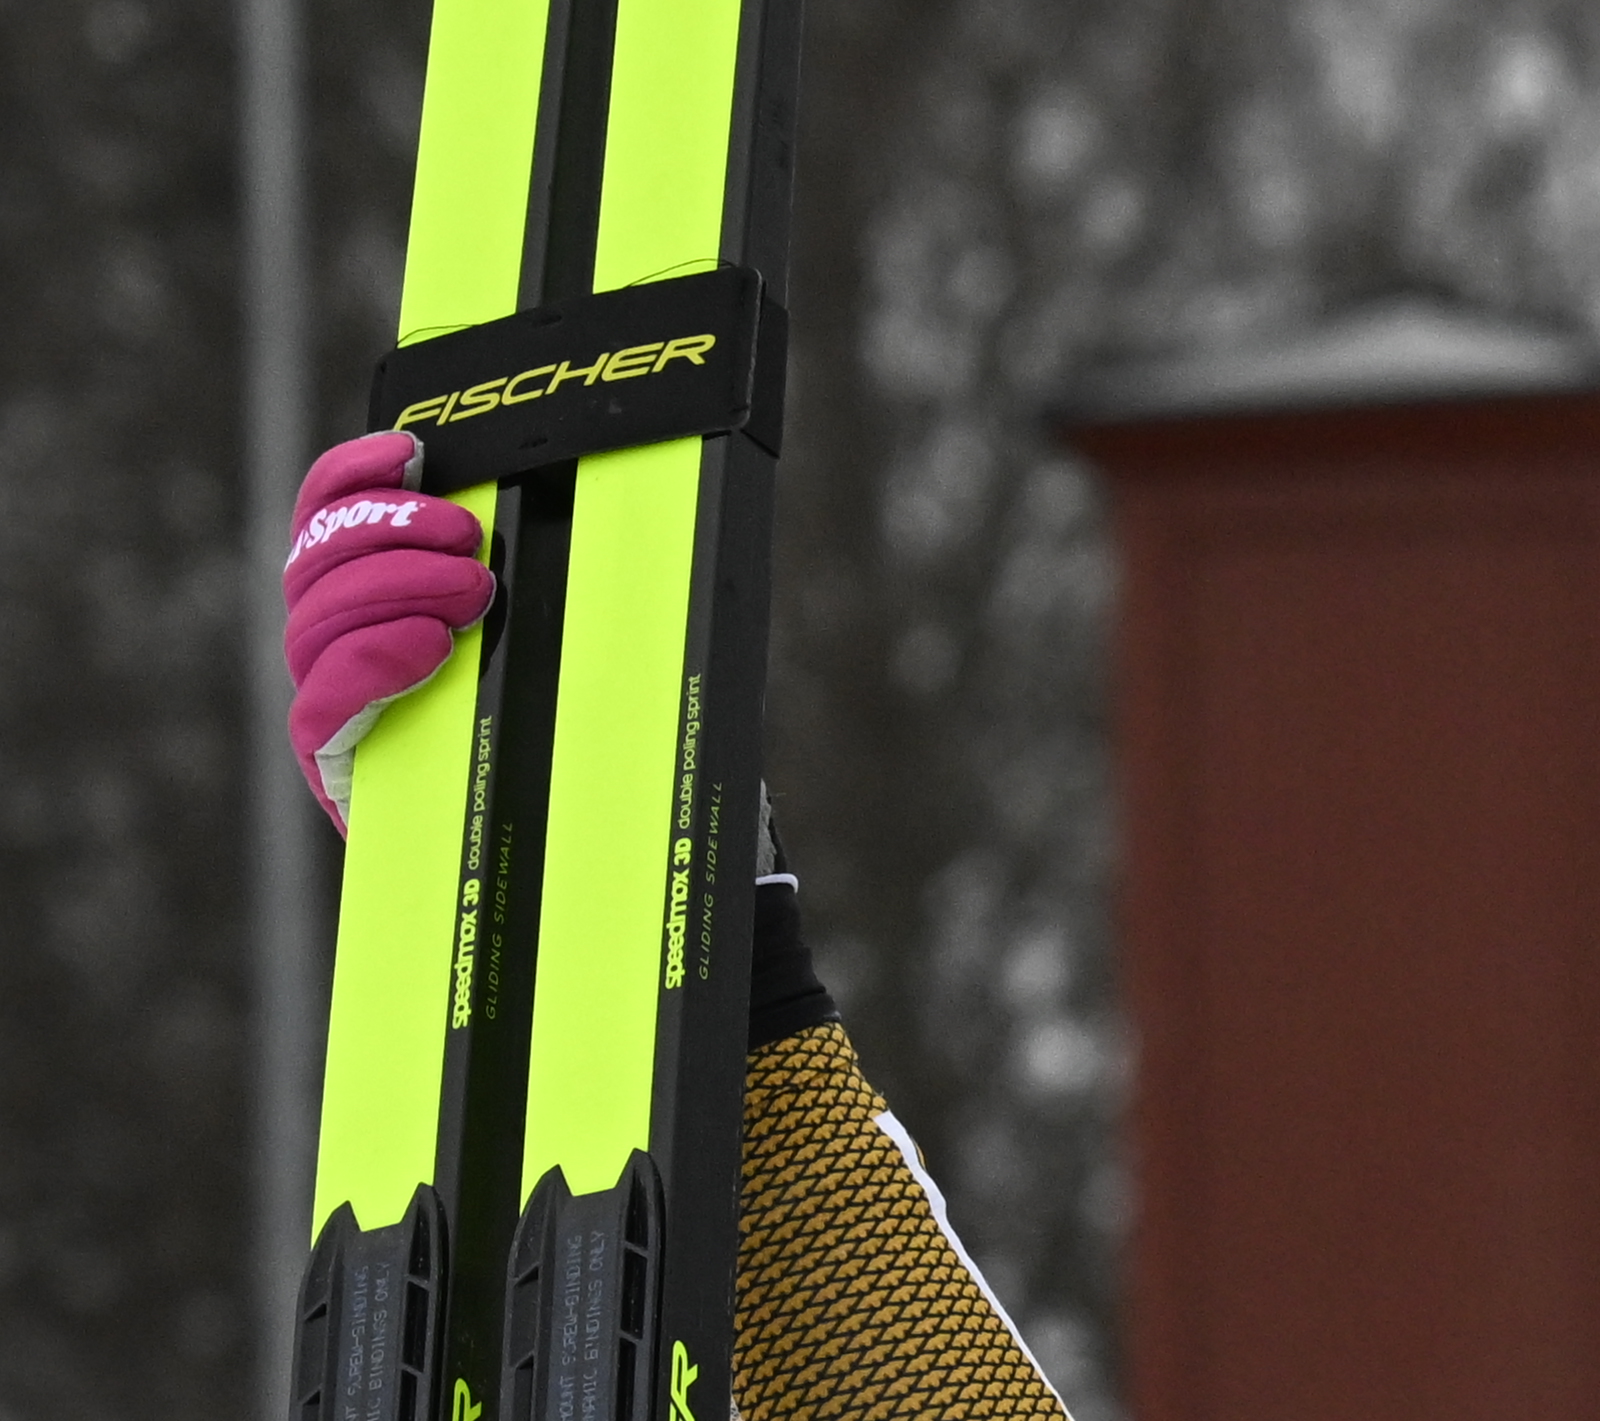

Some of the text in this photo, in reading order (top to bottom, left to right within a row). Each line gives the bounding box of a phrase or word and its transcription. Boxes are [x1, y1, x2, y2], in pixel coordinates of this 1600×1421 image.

[393, 334, 716, 430] FISCHER
[452, 715, 492, 1029] speedmax 3D double poling sprint
[486, 823, 513, 1020] GLIDING SIDEWALL
[665, 673, 701, 989] speedmax 3D double poling sprint
[699, 782, 722, 980] GLIDING SIDEWALL
